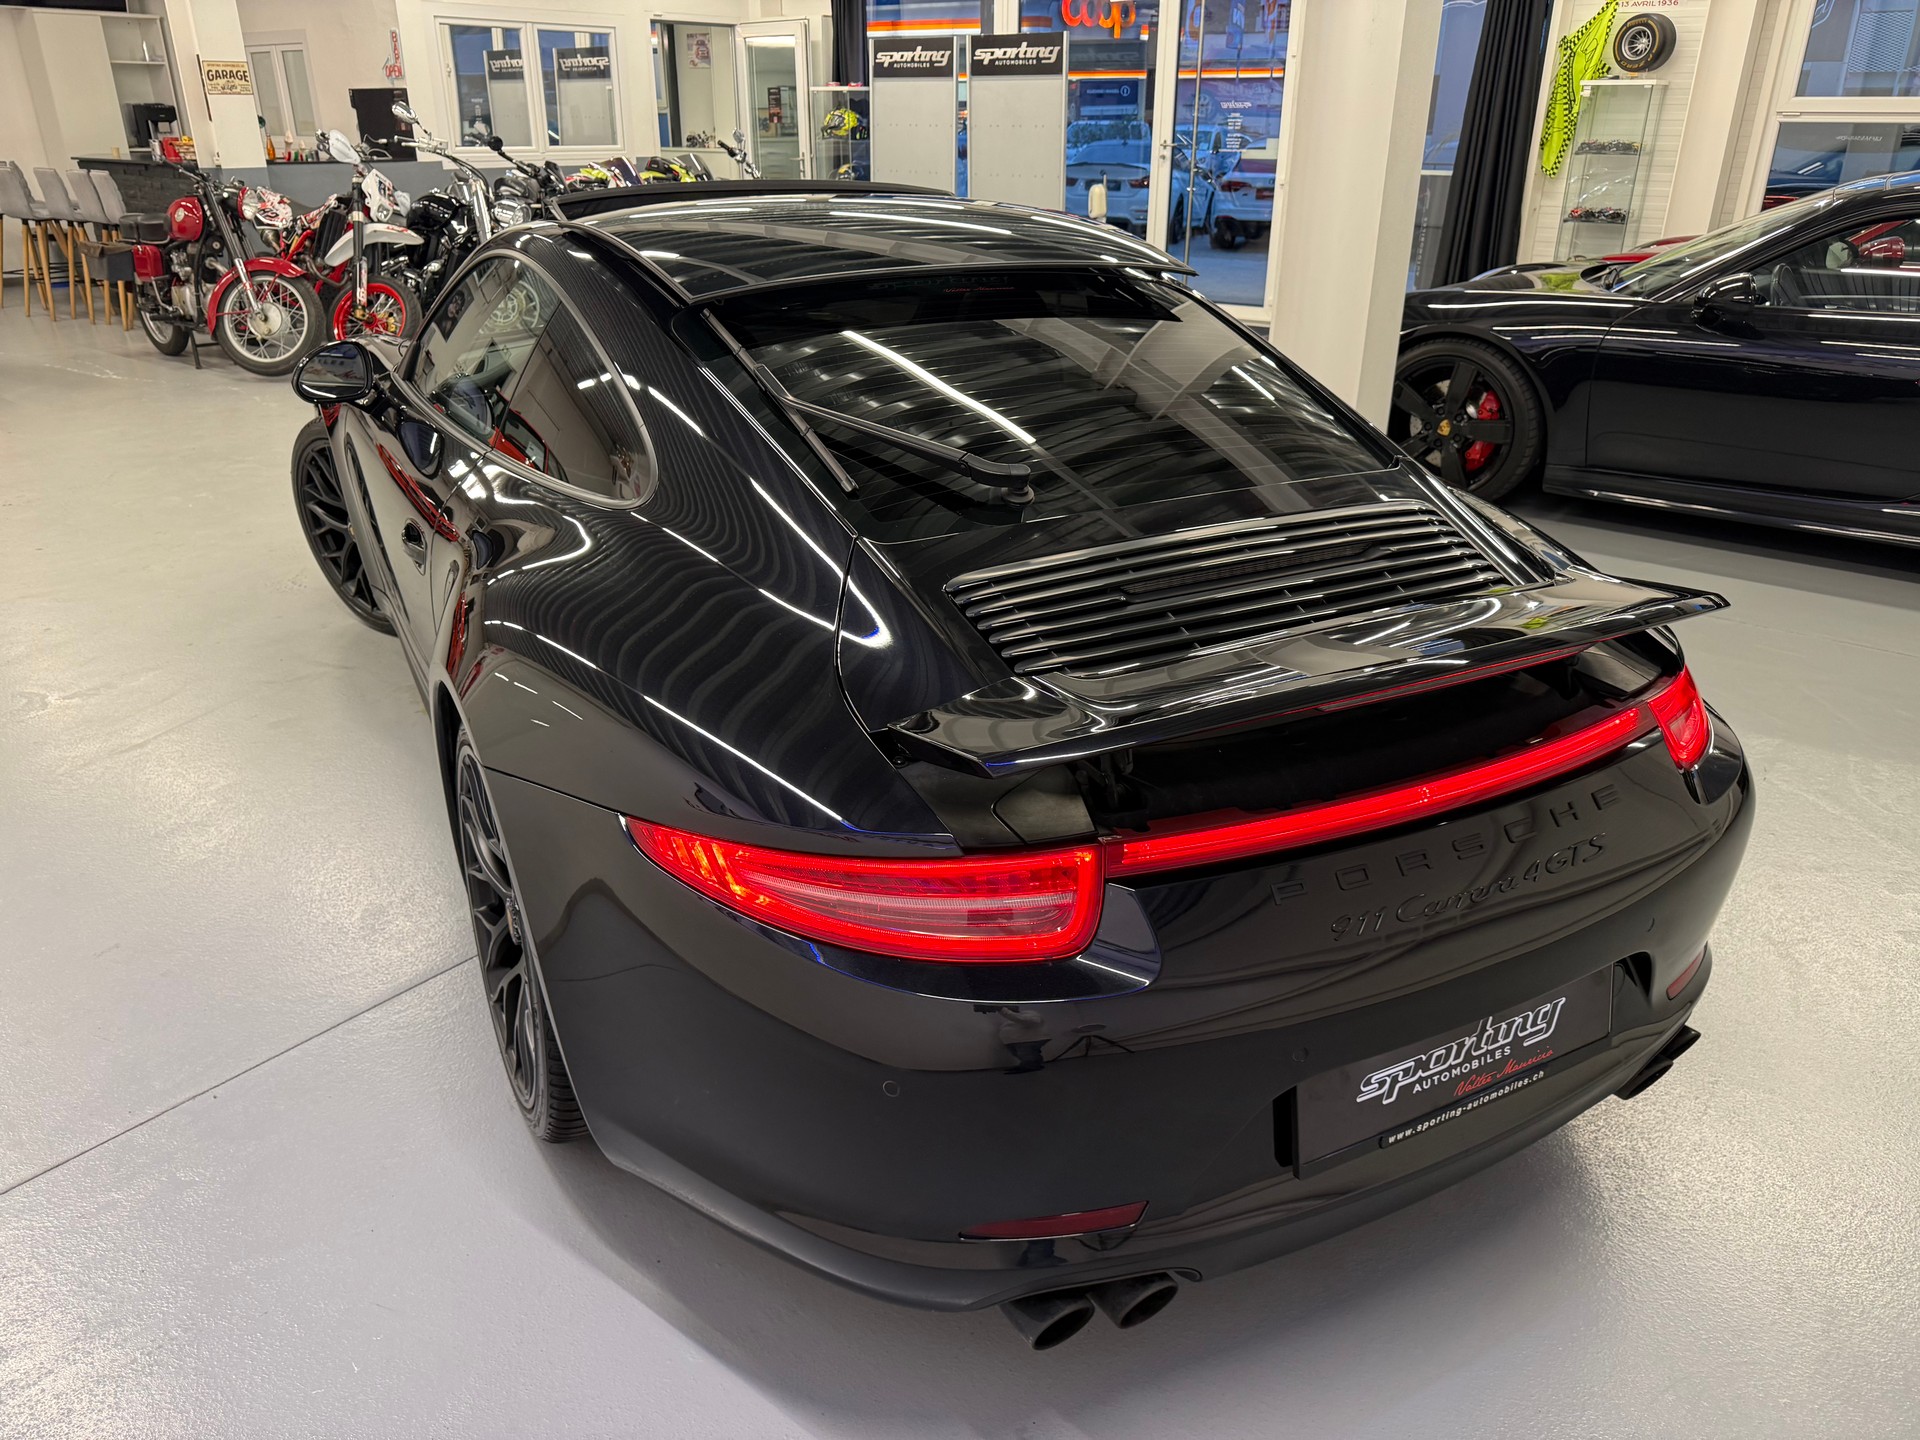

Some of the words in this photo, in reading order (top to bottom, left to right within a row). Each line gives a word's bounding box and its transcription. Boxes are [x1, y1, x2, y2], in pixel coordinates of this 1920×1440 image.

[206, 69, 250, 83] GARAGE
[875, 45, 952, 68] sporting
[973, 41, 1062, 65] sporting
[1270, 784, 1621, 906] PORSCHE
[1331, 906, 1389, 942] 911
[1395, 874, 1520, 923] Carrera
[1356, 996, 1566, 1105] sporting
[1412, 1045, 1511, 1094] AUTOMOBILES
[1388, 1070, 1545, 1144] www.sporting-automobiles.ch
